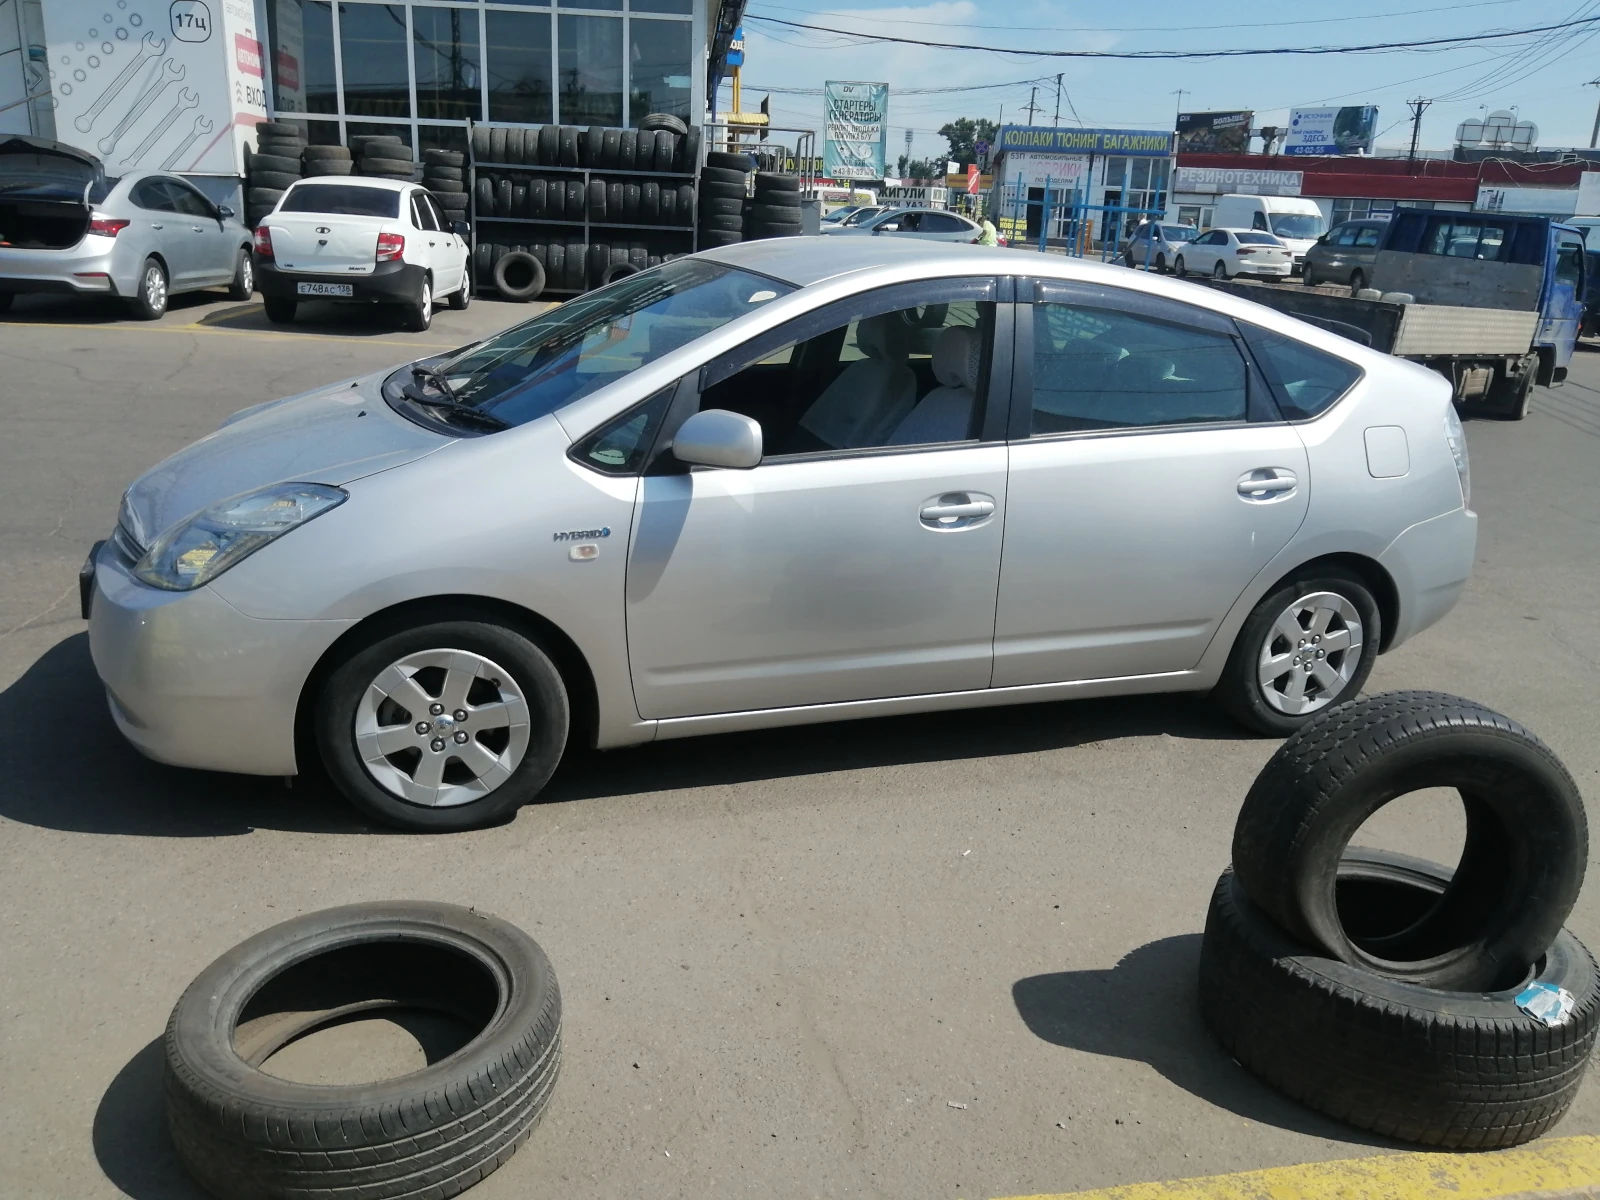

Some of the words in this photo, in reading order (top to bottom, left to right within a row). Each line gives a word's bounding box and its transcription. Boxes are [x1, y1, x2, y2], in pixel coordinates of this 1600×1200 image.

[175, 13, 206, 31] 17ц
[246, 85, 267, 112] ВХОД
[833, 99, 877, 112] СТАРТЕРЫ
[829, 109, 882, 122] ГЕНЕРАТОРЫ
[851, 125, 880, 134] ПРОДАЖА
[1004, 130, 1053, 147] КОЛПАКИ
[1056, 132, 1099, 149] ТЮНИНГ
[1103, 134, 1168, 151] БАГАЖНИКИ
[1010, 152, 1025, 160] 53П
[1029, 154, 1082, 162] АВТОМОБИЛЬНЫЕ
[1178, 168, 1299, 186] РЕЗИНОТЕХНИКА
[877, 187, 926, 199] ЖИГУЛИ
[553, 528, 603, 542] HYBRID
